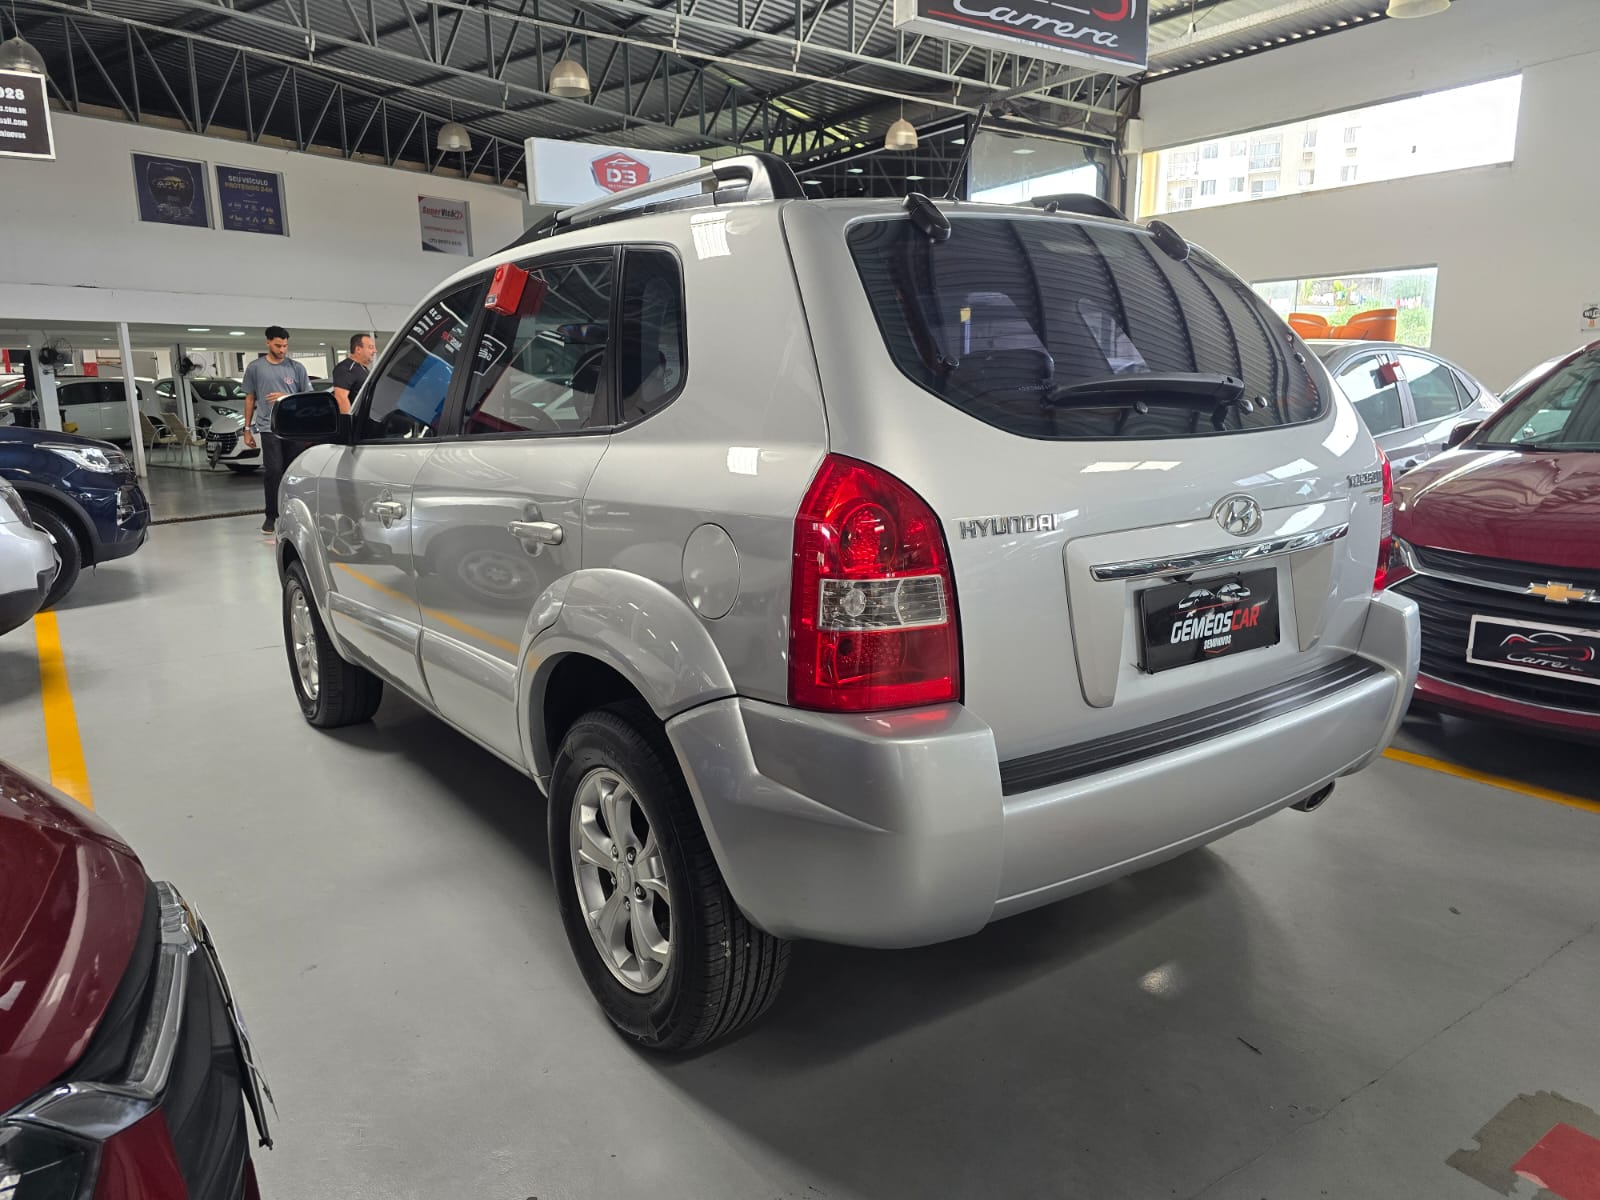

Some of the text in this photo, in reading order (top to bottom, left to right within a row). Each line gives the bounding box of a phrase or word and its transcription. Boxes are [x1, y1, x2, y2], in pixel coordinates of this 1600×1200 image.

[953, 0, 1119, 47] Carrera
[606, 167, 637, 184] D3
[959, 513, 1057, 539] HYUNDAI
